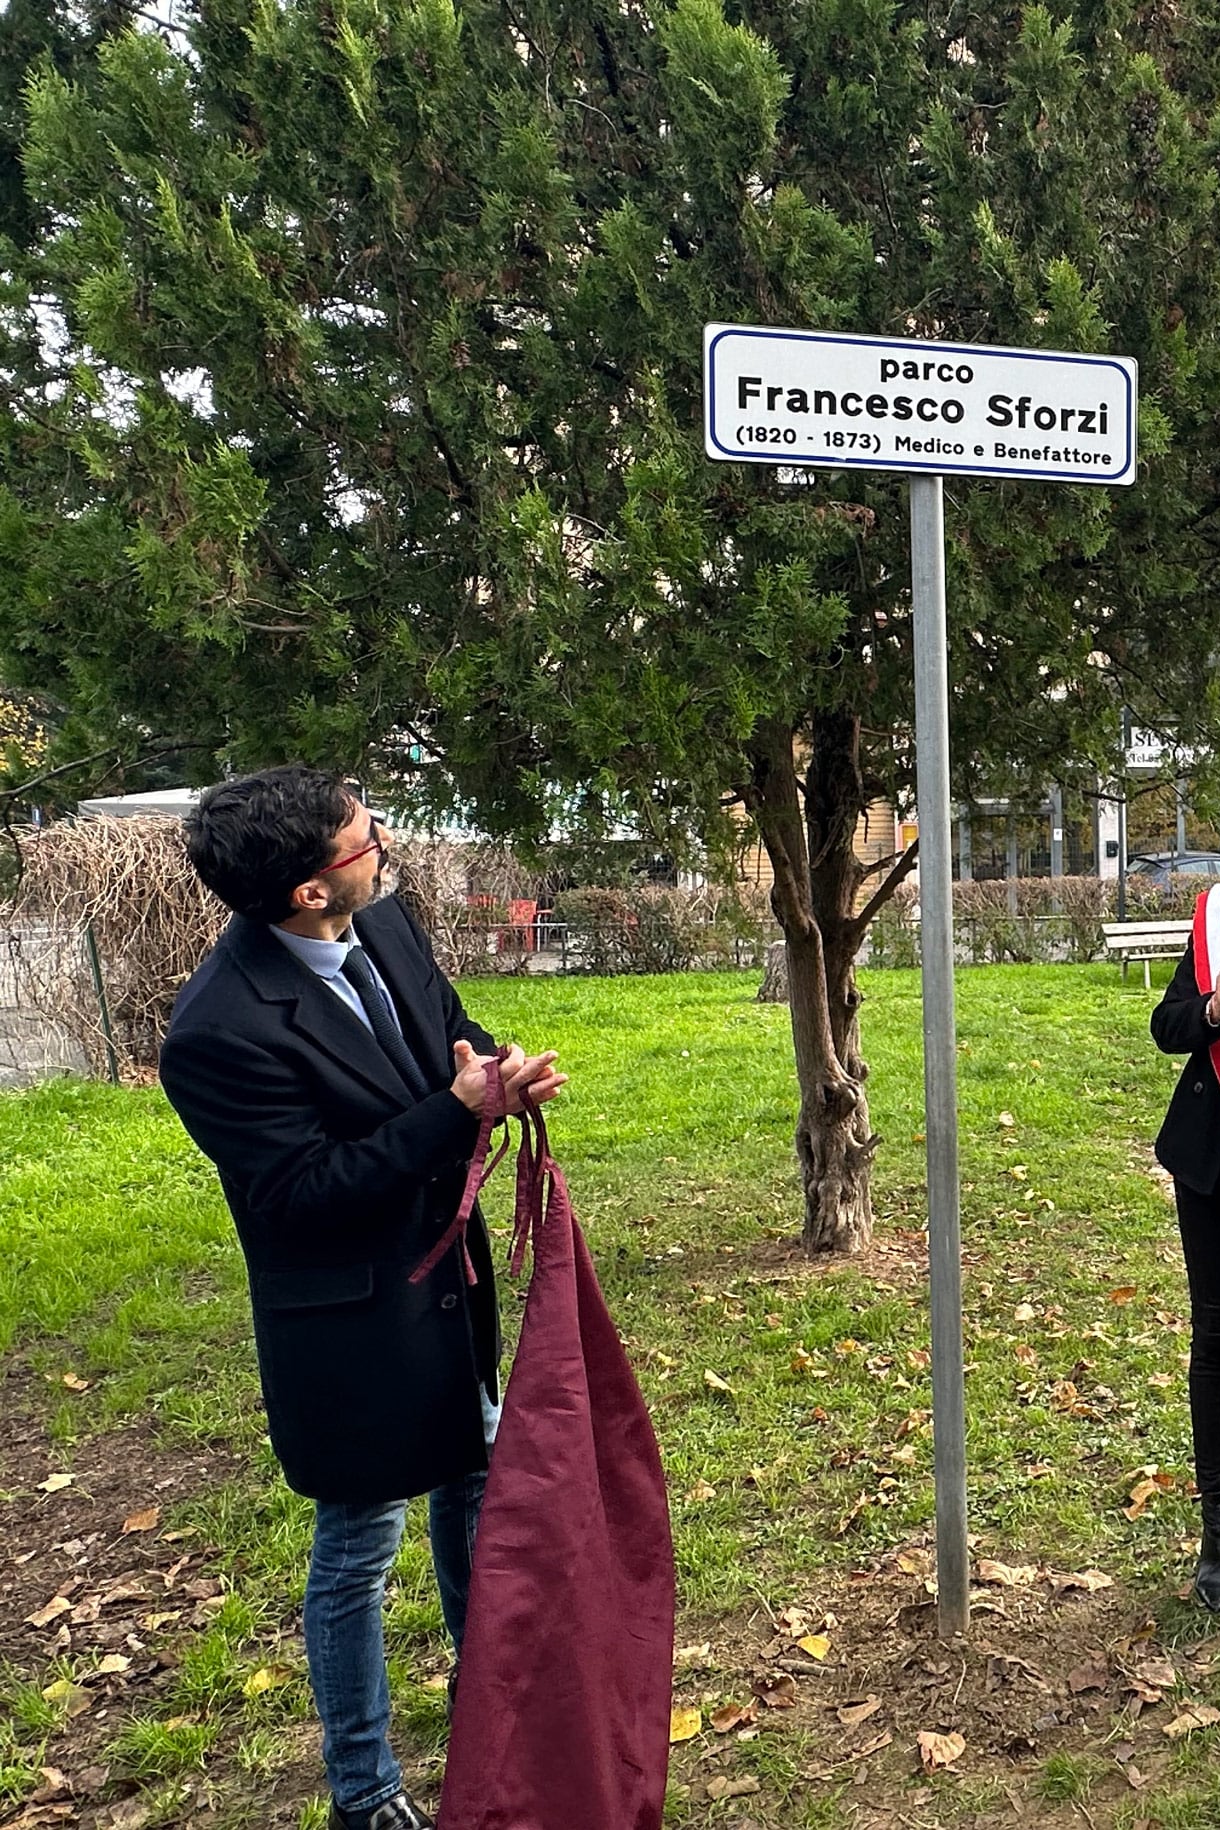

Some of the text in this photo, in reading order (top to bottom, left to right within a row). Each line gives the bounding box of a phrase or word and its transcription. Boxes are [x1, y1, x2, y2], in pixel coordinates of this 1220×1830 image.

[880, 358, 974, 384] parco
[738, 375, 1108, 435] Francesco Sforzi
[736, 425, 797, 446] (1820
[823, 430, 882, 454] 1873)
[895, 435, 965, 456] Medico
[973, 444, 985, 457] e
[994, 442, 1112, 466] Benefattore
